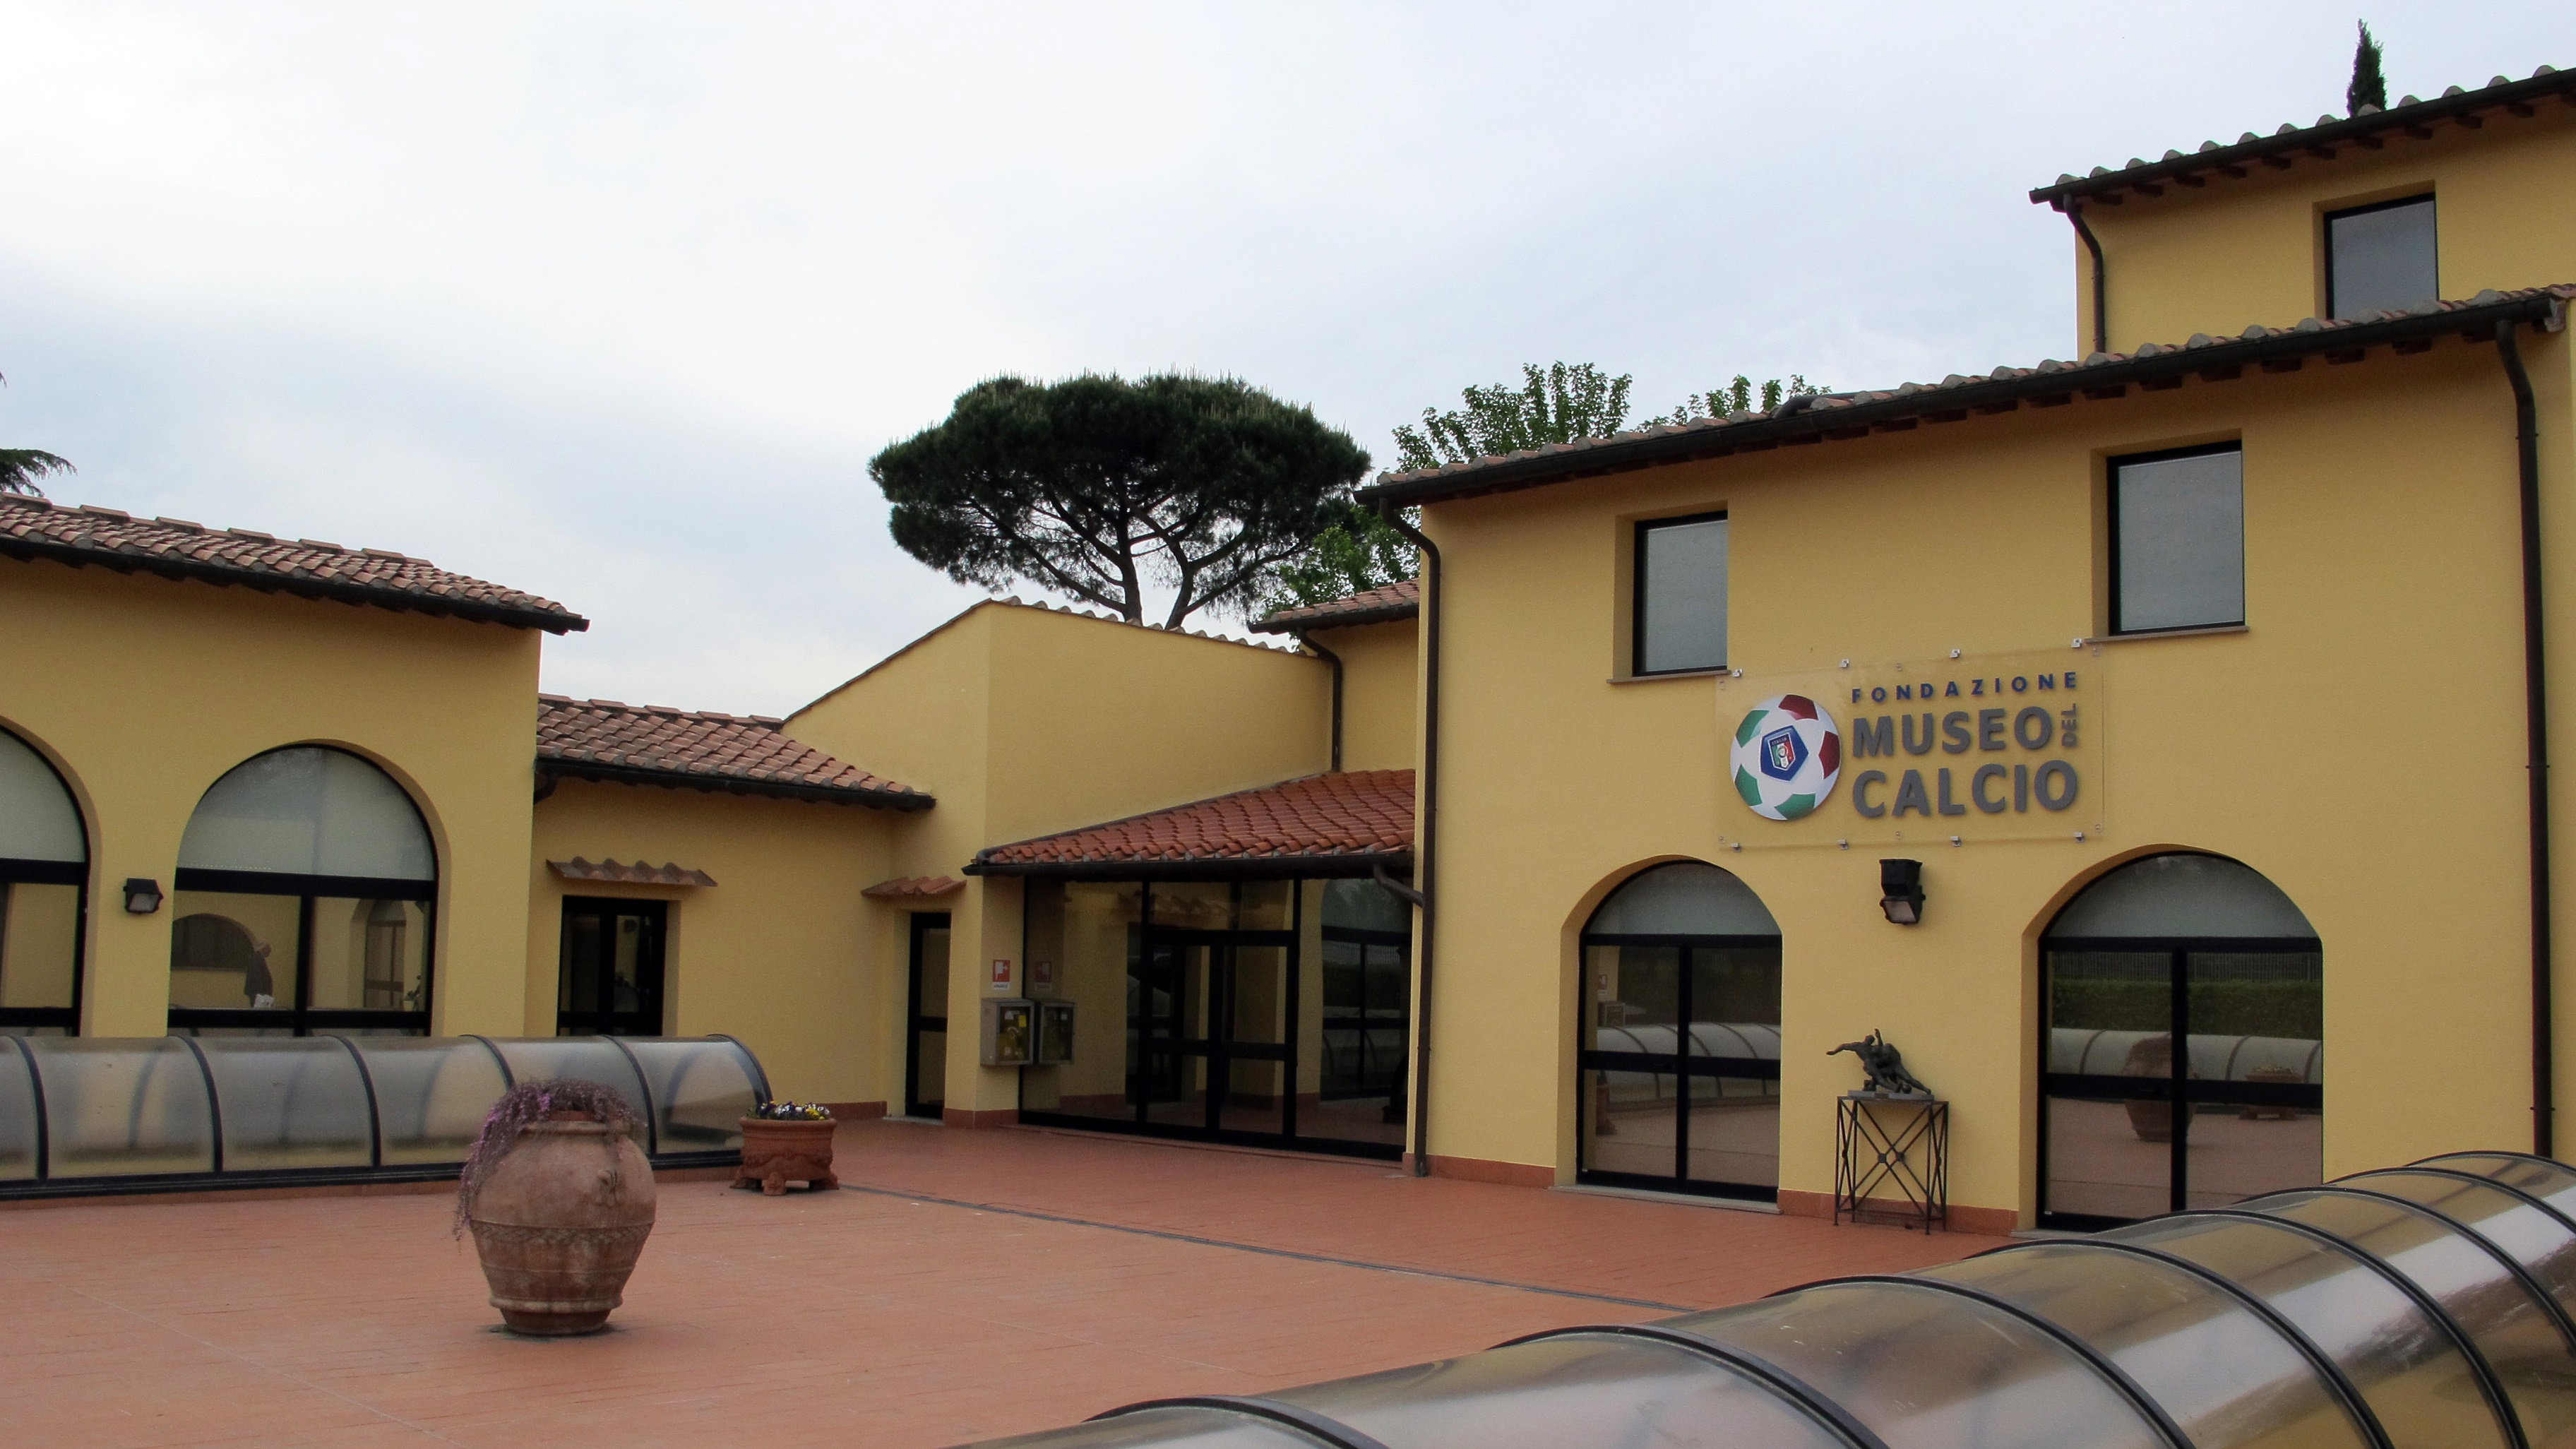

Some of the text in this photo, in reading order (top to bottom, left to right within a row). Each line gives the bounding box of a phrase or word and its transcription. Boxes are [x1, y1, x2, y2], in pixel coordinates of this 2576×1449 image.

[1852, 672, 2077, 703] FONDAZIONE
[1852, 706, 2052, 757] MUSEO
[2061, 703, 2077, 747] DEL
[1852, 760, 2077, 818] CALCIO
